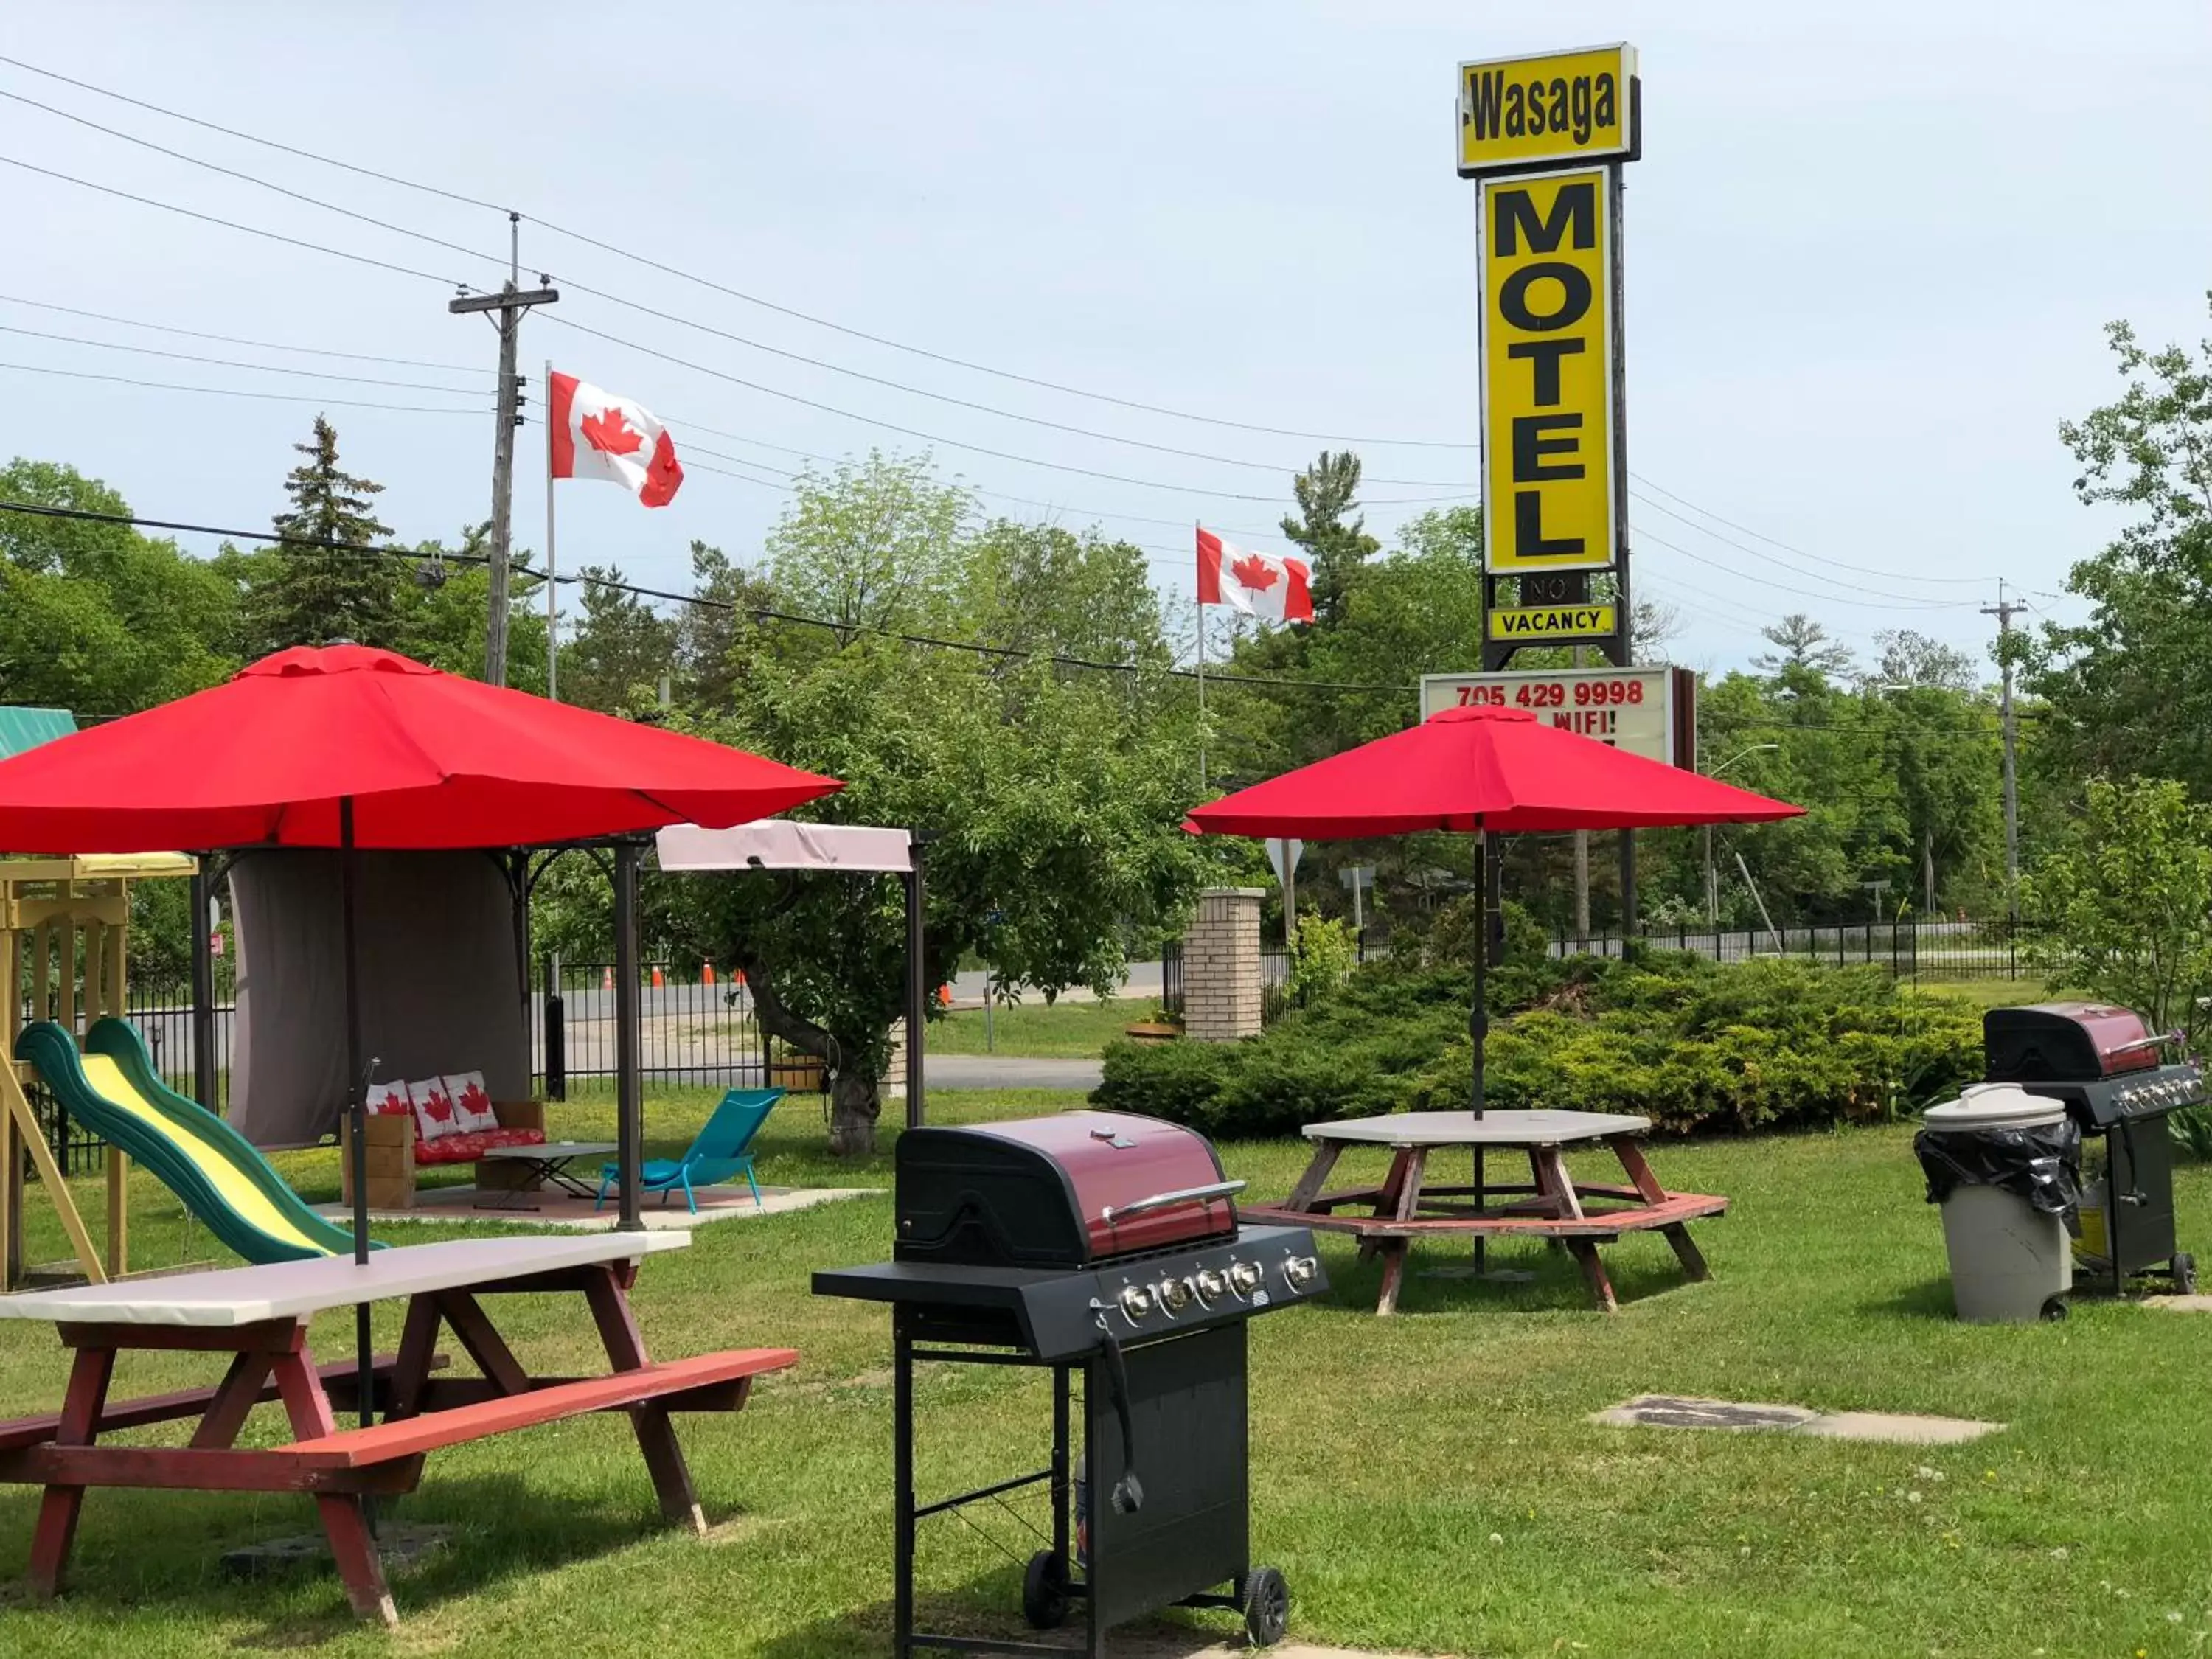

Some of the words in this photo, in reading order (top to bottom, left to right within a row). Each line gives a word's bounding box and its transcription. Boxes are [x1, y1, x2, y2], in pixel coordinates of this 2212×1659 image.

[1470, 70, 1615, 145] Wasaga
[1495, 183, 1595, 557] MOTEL
[1531, 577, 1567, 602] NO
[1502, 611, 1601, 632] VACANCY
[1456, 686, 1506, 706] 705
[1516, 684, 1565, 707] 429
[1574, 680, 1644, 706] 9998
[1553, 711, 1616, 734] WIFI!
